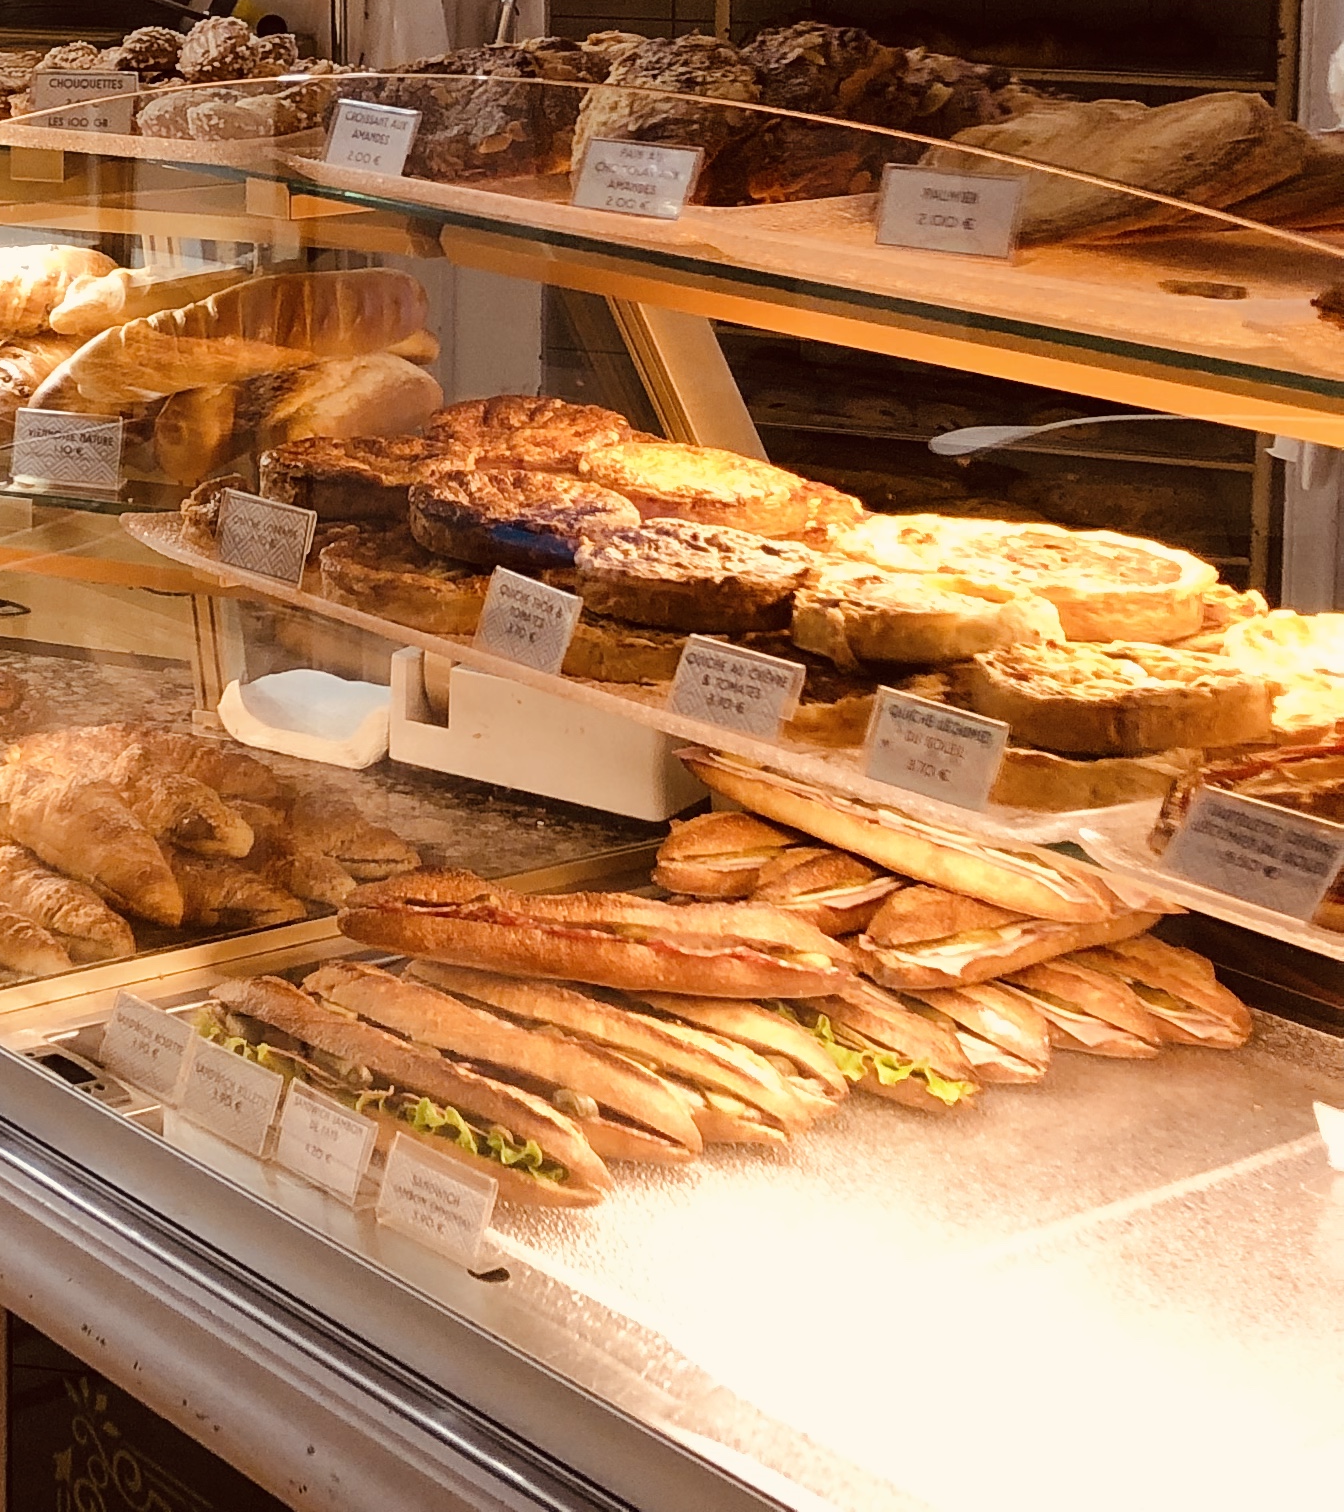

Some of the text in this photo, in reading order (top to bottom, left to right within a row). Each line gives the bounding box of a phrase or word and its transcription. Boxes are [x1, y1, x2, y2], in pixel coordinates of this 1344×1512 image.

[48, 78, 123, 90] CHOUQUETTES
[48, 117, 65, 128] LES
[67, 117, 89, 128] 100
[345, 111, 409, 130] CROISSANT AUX
[351, 128, 389, 145] AMANDES
